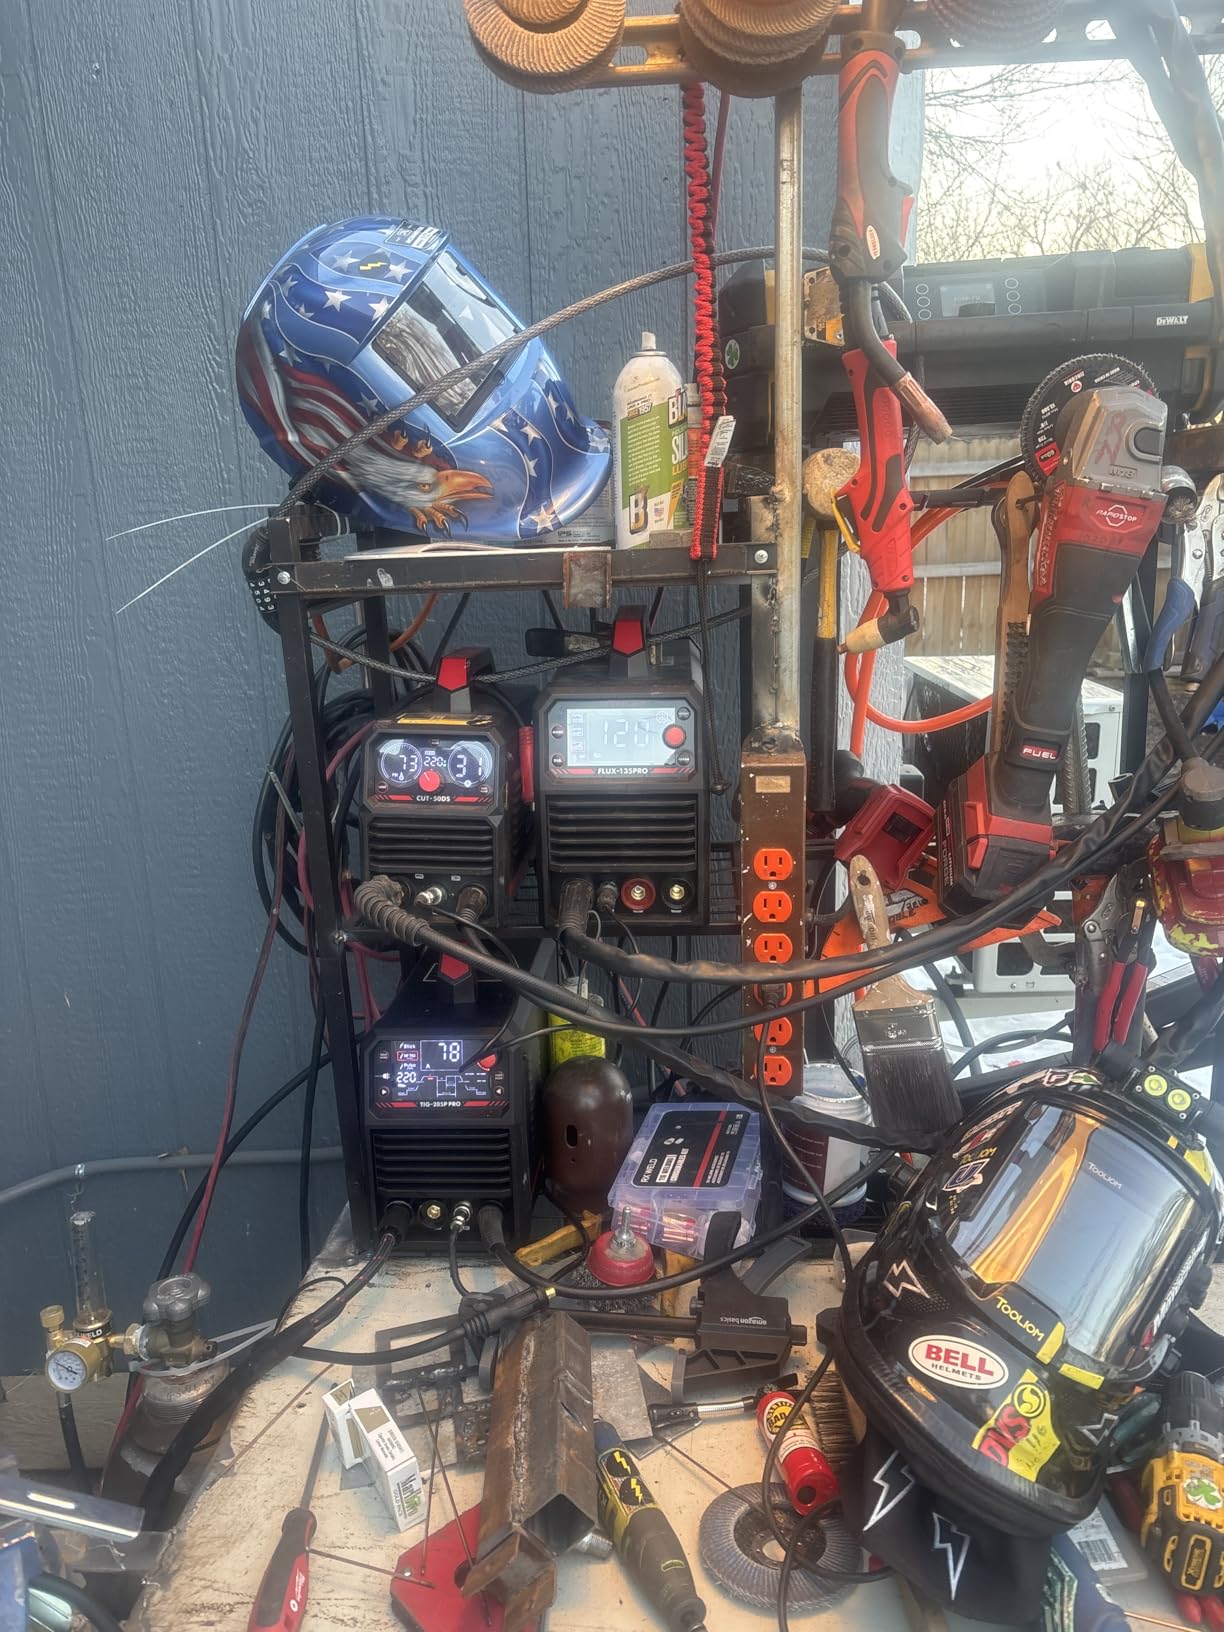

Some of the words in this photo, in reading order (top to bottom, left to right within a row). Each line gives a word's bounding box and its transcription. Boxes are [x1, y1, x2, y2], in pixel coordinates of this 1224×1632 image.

[1022, 747, 1058, 760] FUEL
[399, 754, 418, 772] 73
[456, 754, 483, 778] 31
[438, 1042, 460, 1062] 78
[396, 1072, 417, 1083] 220
[644, 1158, 658, 1174] WELD
[641, 1174, 651, 1182] RX
[1088, 1161, 1122, 1190] TOOLIOM
[720, 1316, 740, 1324] basics
[740, 1316, 767, 1325] amazon
[996, 1296, 1044, 1342] TOOLIOM
[924, 1344, 994, 1378] BELL
[931, 1364, 982, 1380] HELMETS
